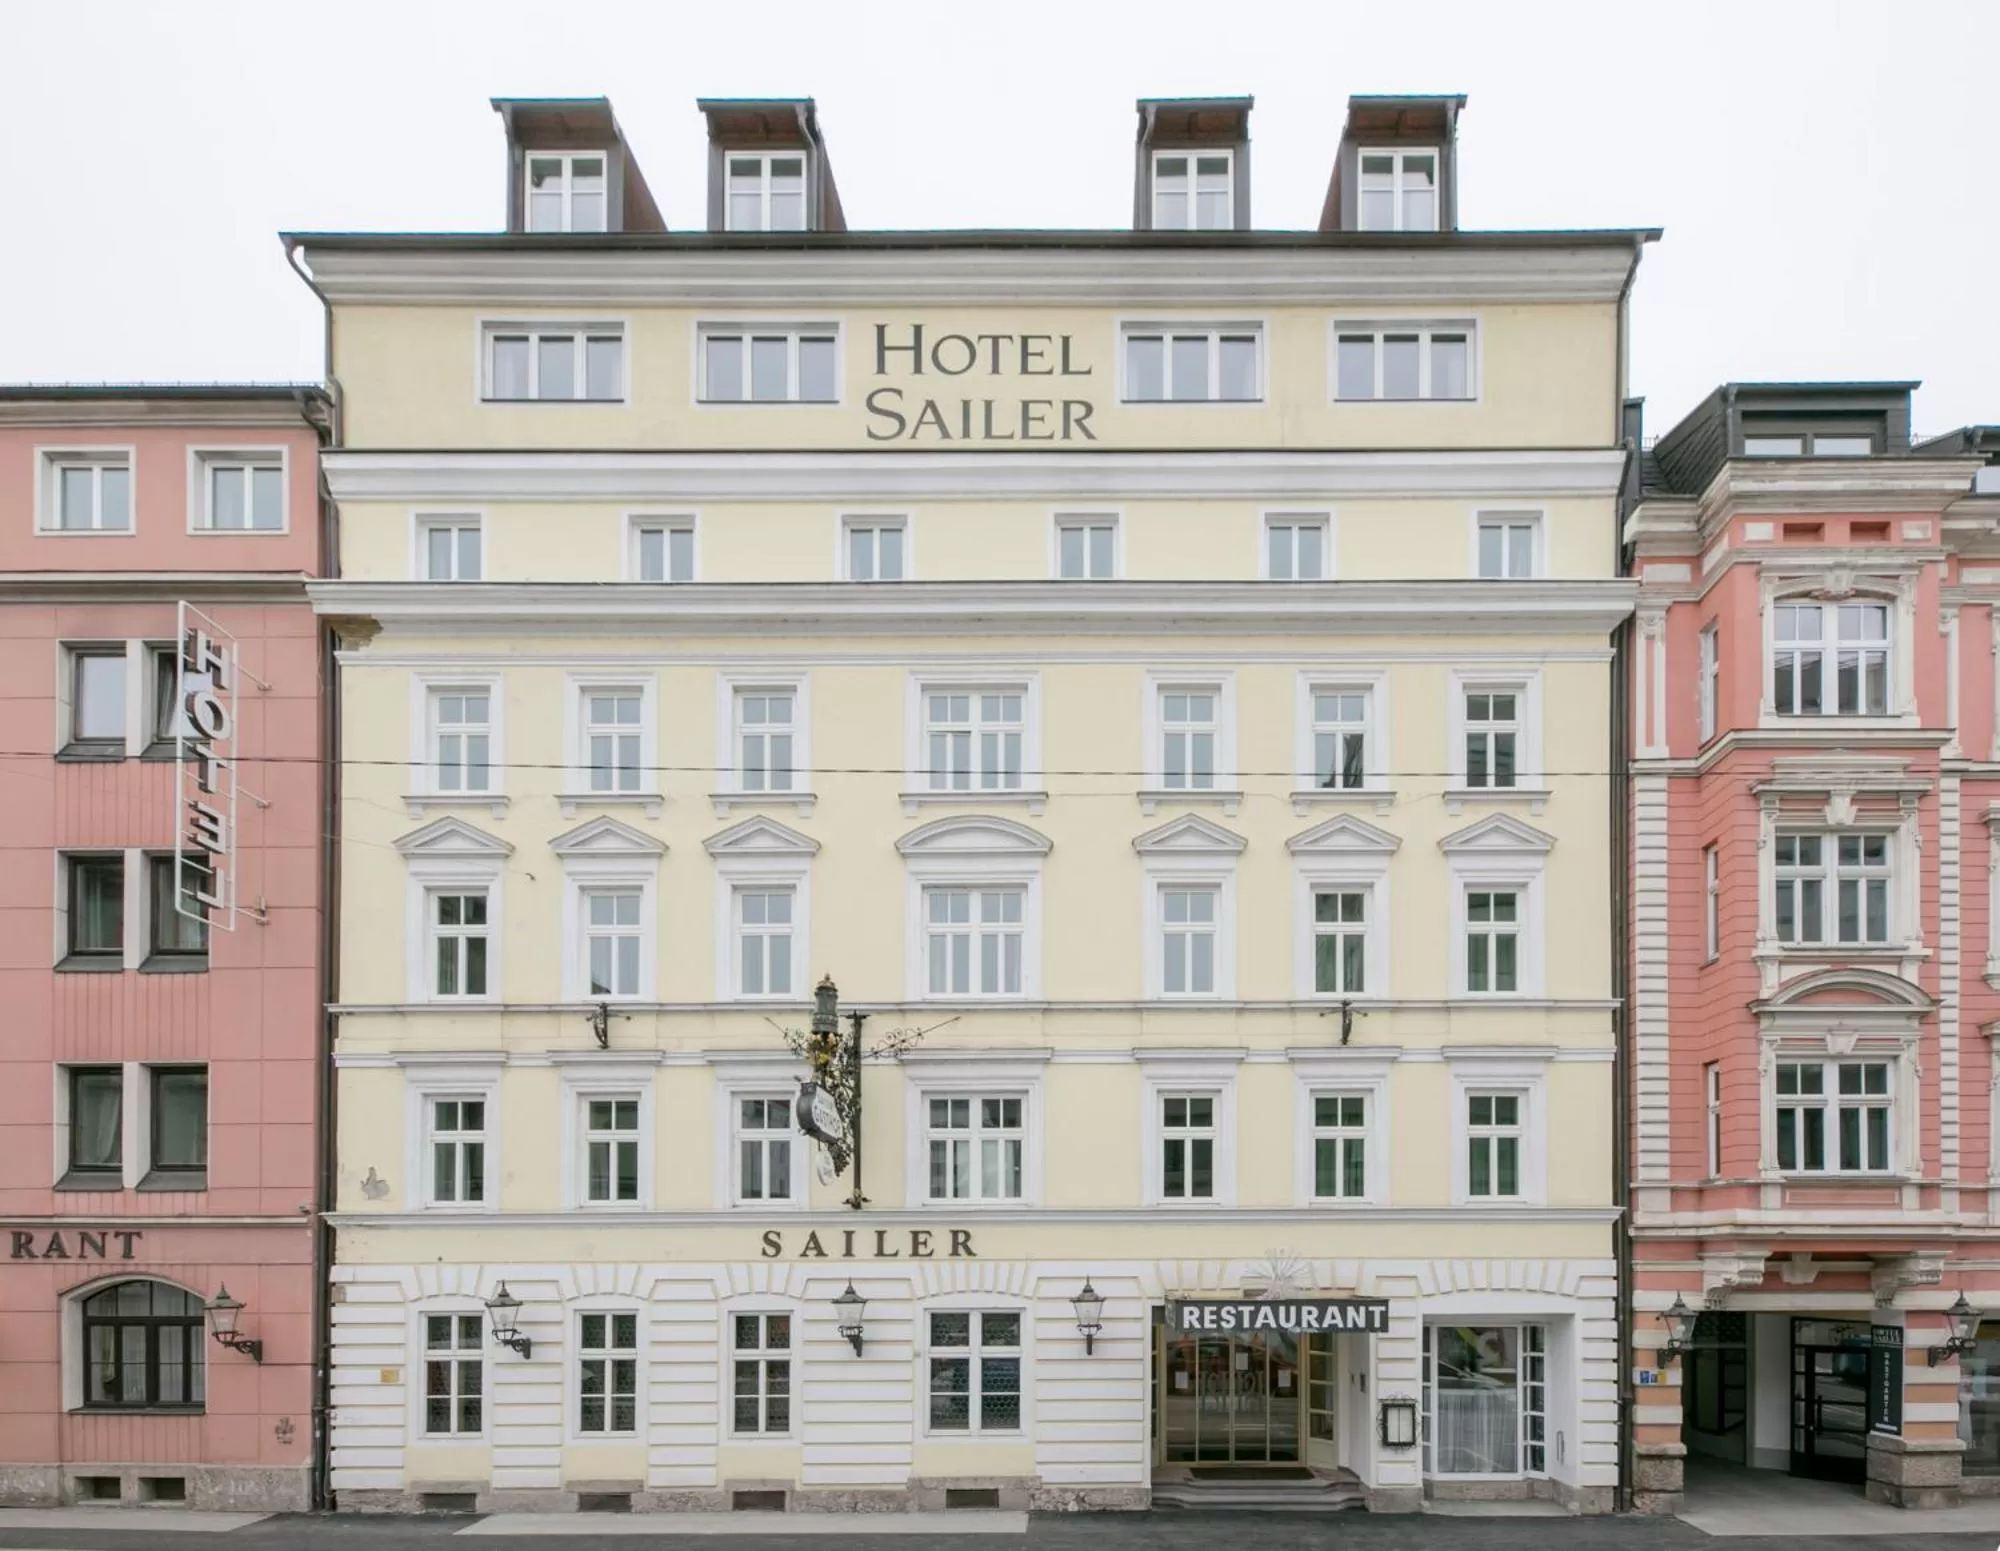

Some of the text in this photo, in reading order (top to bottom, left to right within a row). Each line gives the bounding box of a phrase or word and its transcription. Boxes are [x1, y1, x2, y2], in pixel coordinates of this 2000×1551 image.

[873, 323, 1092, 375] HOTEL
[866, 387, 1097, 440] SAILER
[10, 1231, 142, 1259] RANT
[761, 1229, 977, 1258] SAILER
[1183, 1306, 1386, 1329] RESTAURANT
